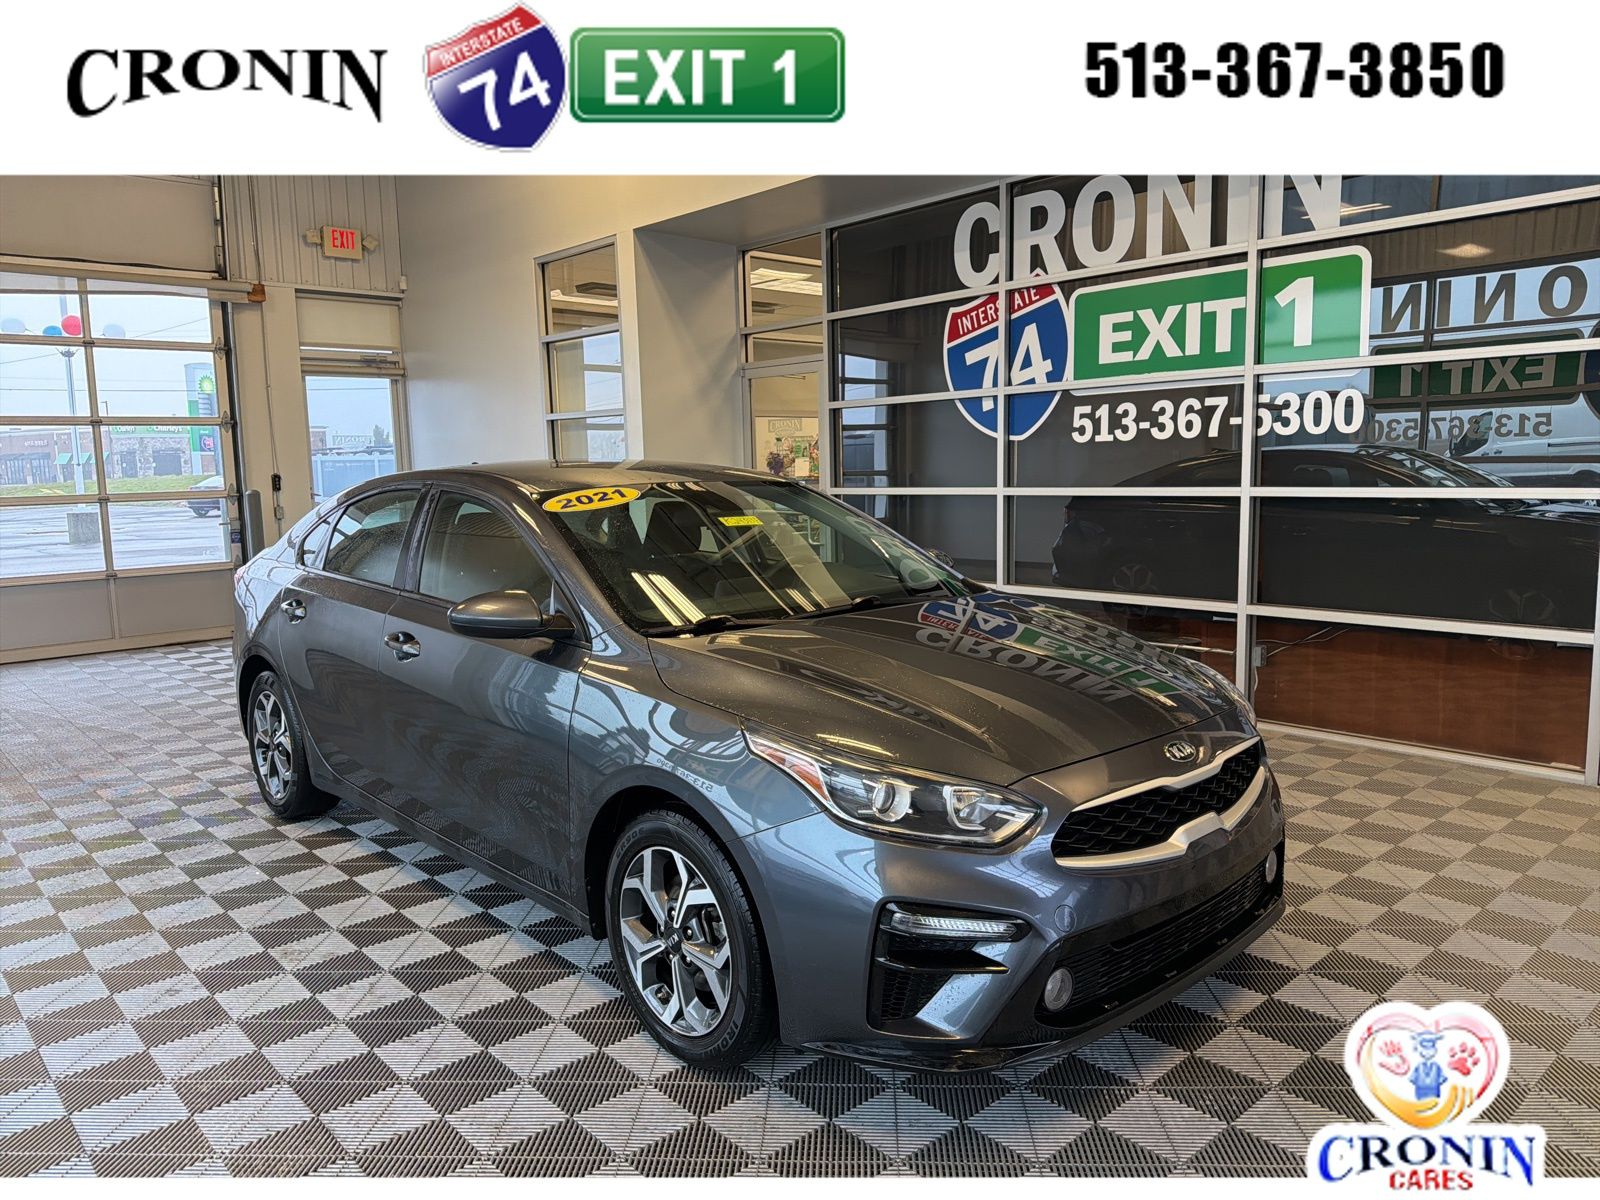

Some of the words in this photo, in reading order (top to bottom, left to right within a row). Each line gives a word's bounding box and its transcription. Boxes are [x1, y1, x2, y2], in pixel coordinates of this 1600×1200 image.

[331, 229, 355, 250] EXIT
[954, 174, 1341, 288] CRONIN
[957, 287, 1040, 335] INTERATE
[1099, 296, 1246, 365] EXIT
[1274, 276, 1315, 347] 1
[964, 322, 1053, 412] 74
[1071, 388, 1365, 443] 513-367-5300
[556, 488, 628, 509] 2021
[1169, 743, 1194, 758] KIA
